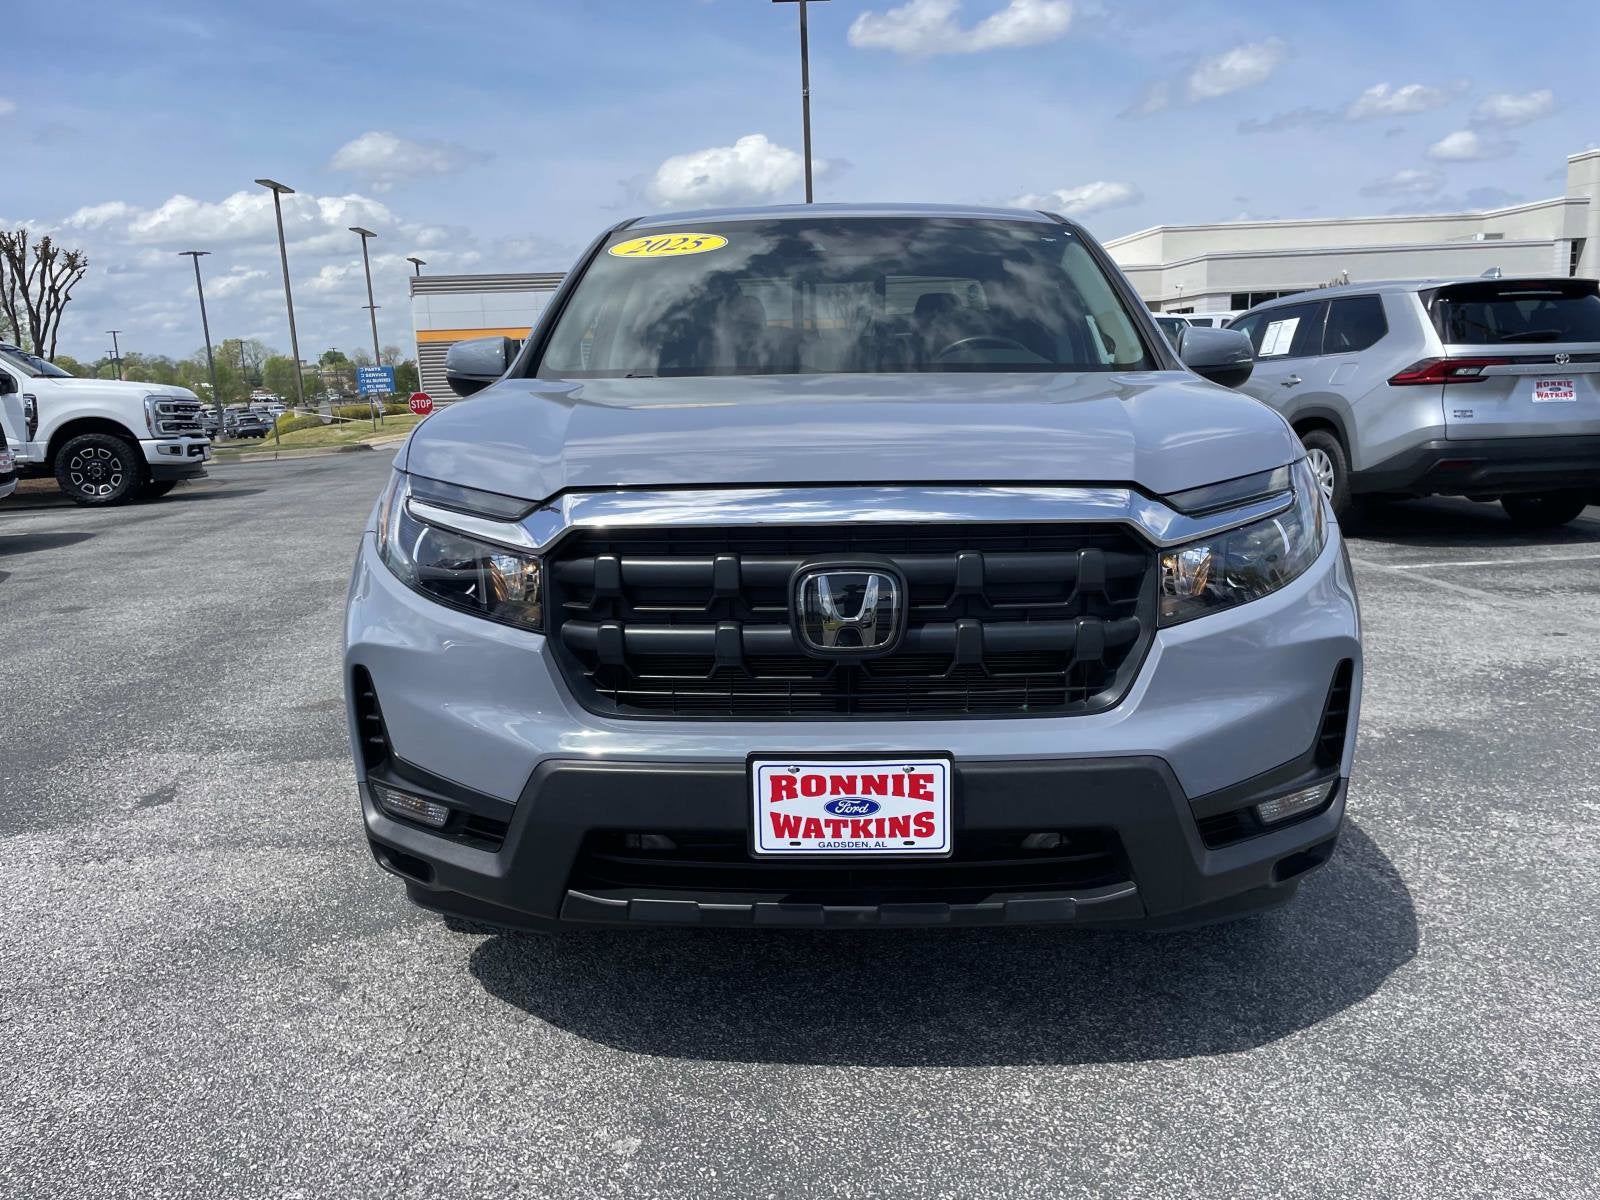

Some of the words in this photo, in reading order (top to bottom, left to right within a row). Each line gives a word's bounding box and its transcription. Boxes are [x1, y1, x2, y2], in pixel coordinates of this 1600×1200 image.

[624, 237, 710, 254] 2025
[1536, 381, 1573, 389] RONNIE
[1536, 391, 1573, 399] WATKINS
[411, 400, 432, 409] STOP
[770, 773, 934, 803] RONNIE
[834, 800, 869, 813] Ford
[770, 811, 936, 839] WATKINS
[818, 841, 871, 849] GADSDEN,
